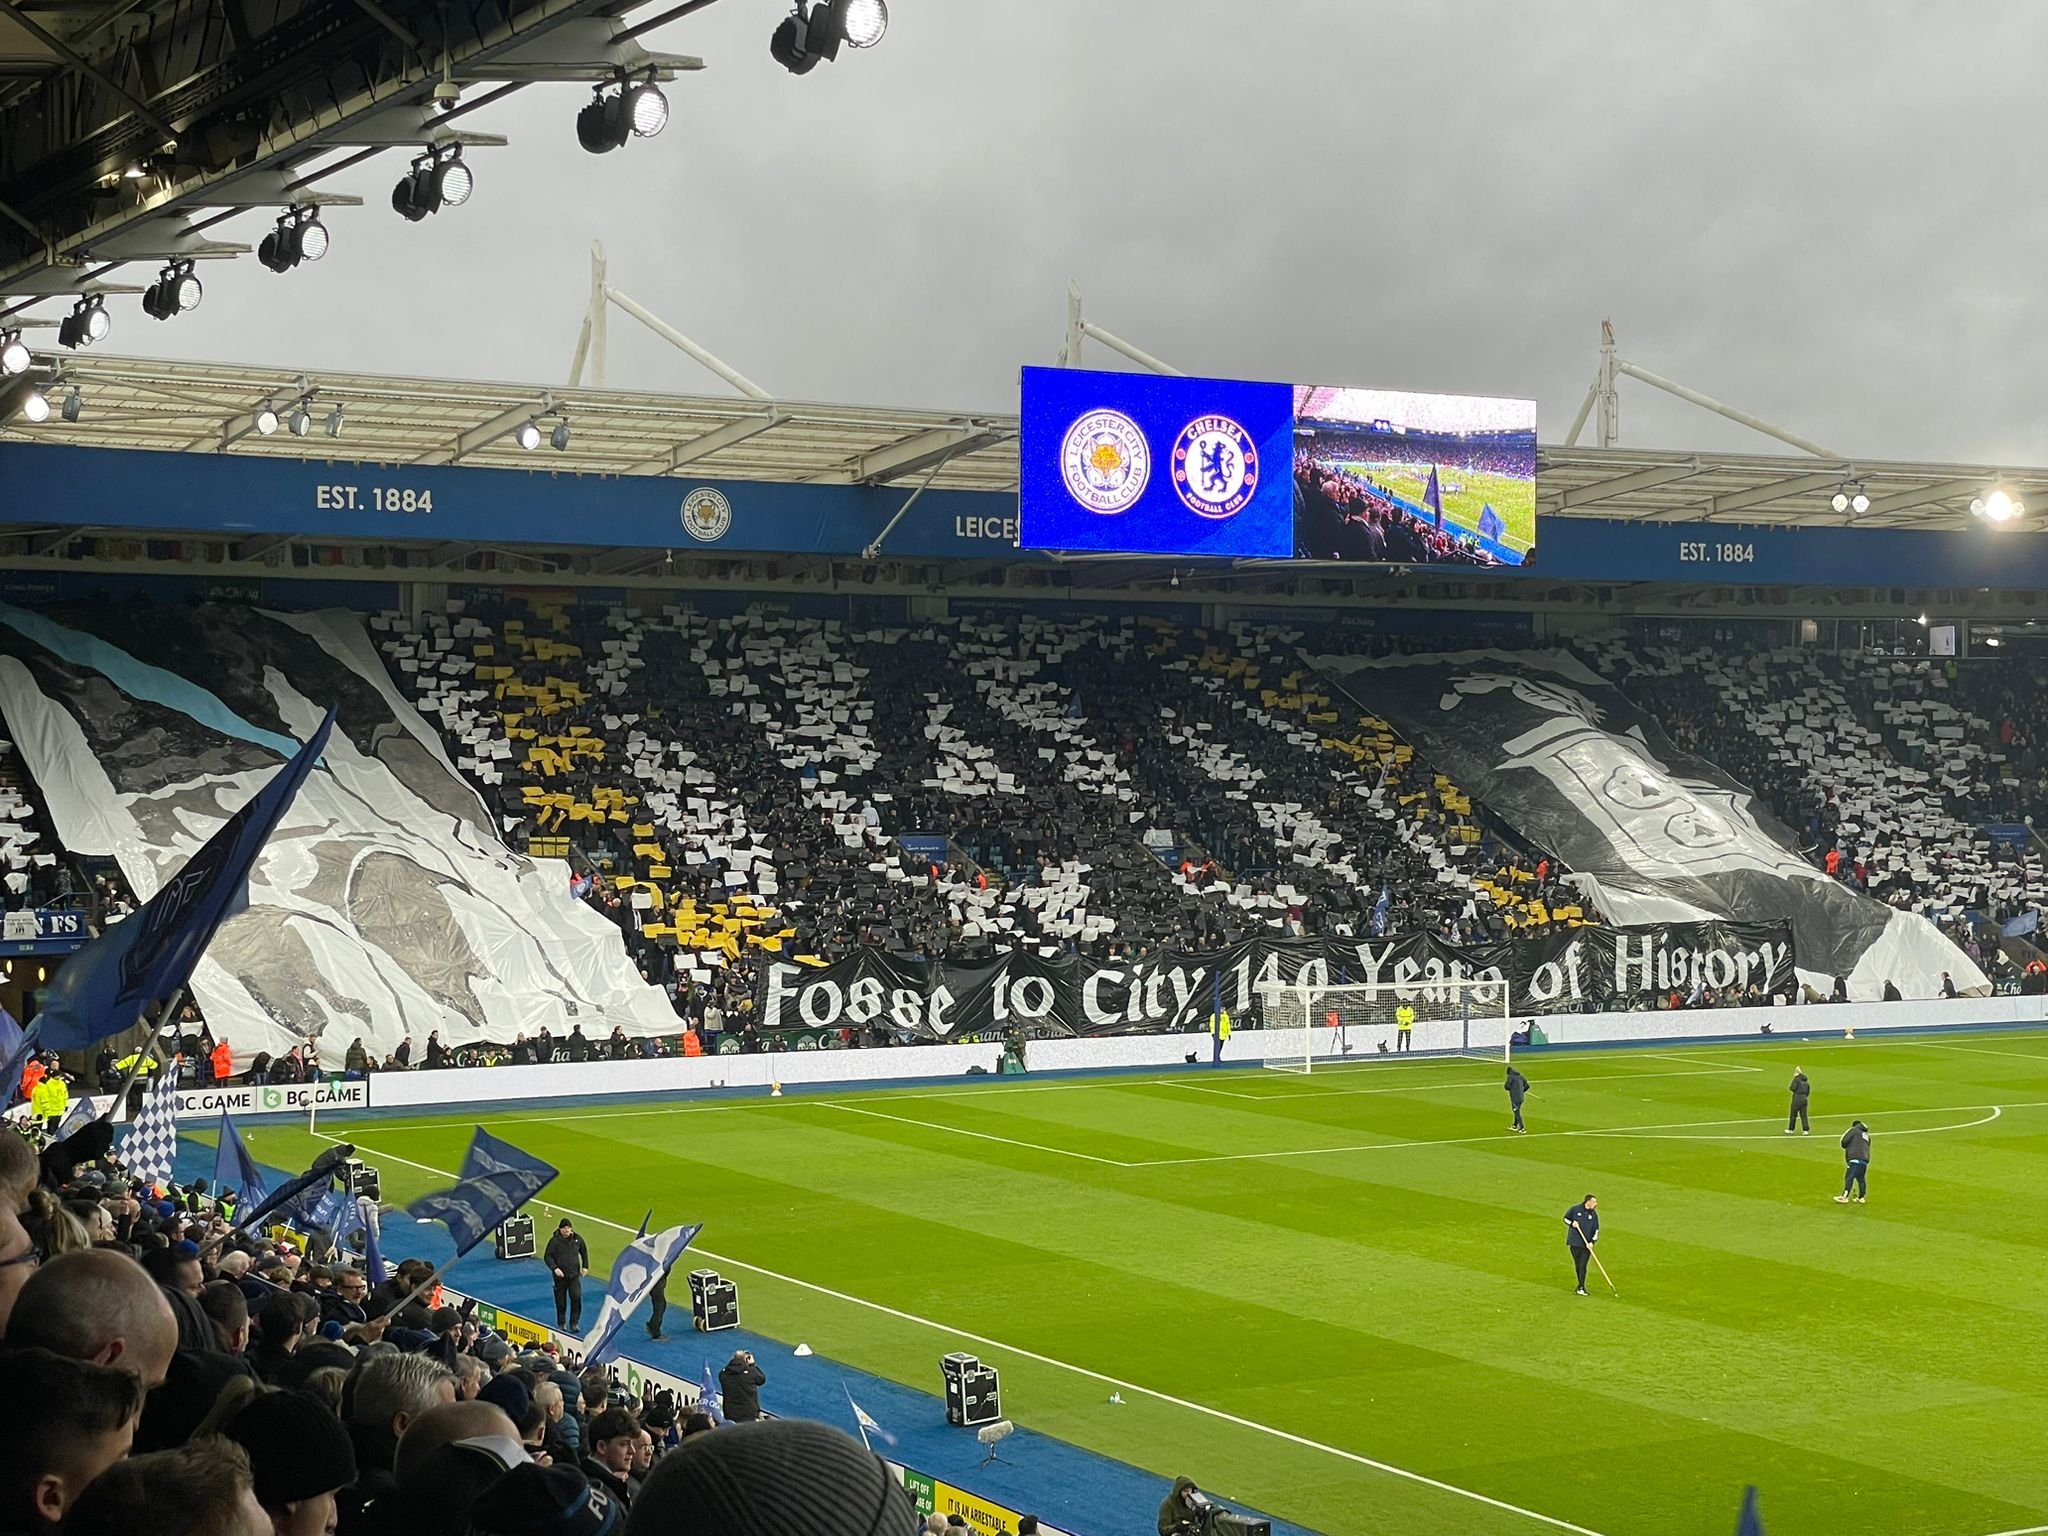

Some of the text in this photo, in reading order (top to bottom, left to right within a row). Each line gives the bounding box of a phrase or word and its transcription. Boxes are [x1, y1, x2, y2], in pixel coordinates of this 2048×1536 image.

[1071, 418, 1142, 460] LEICESTER CITY
[1187, 418, 1243, 444] CHELSEA
[1069, 464, 1142, 505] FOOTBALL CLUB
[317, 485, 433, 513] EST. 1884
[1186, 492, 1243, 514] FOOTBALL CLUB
[1680, 542, 1754, 562] EST. 1884
[50, 915, 78, 934] FS
[763, 931, 1787, 1036] Fosse to City, 140 Years of History
[287, 1087, 361, 1105] BC.GAME
[909, 1480, 930, 1496] LIFT OFF
[962, 1503, 970, 1518] AN
[970, 1507, 1006, 1531] ARRESTABLE
